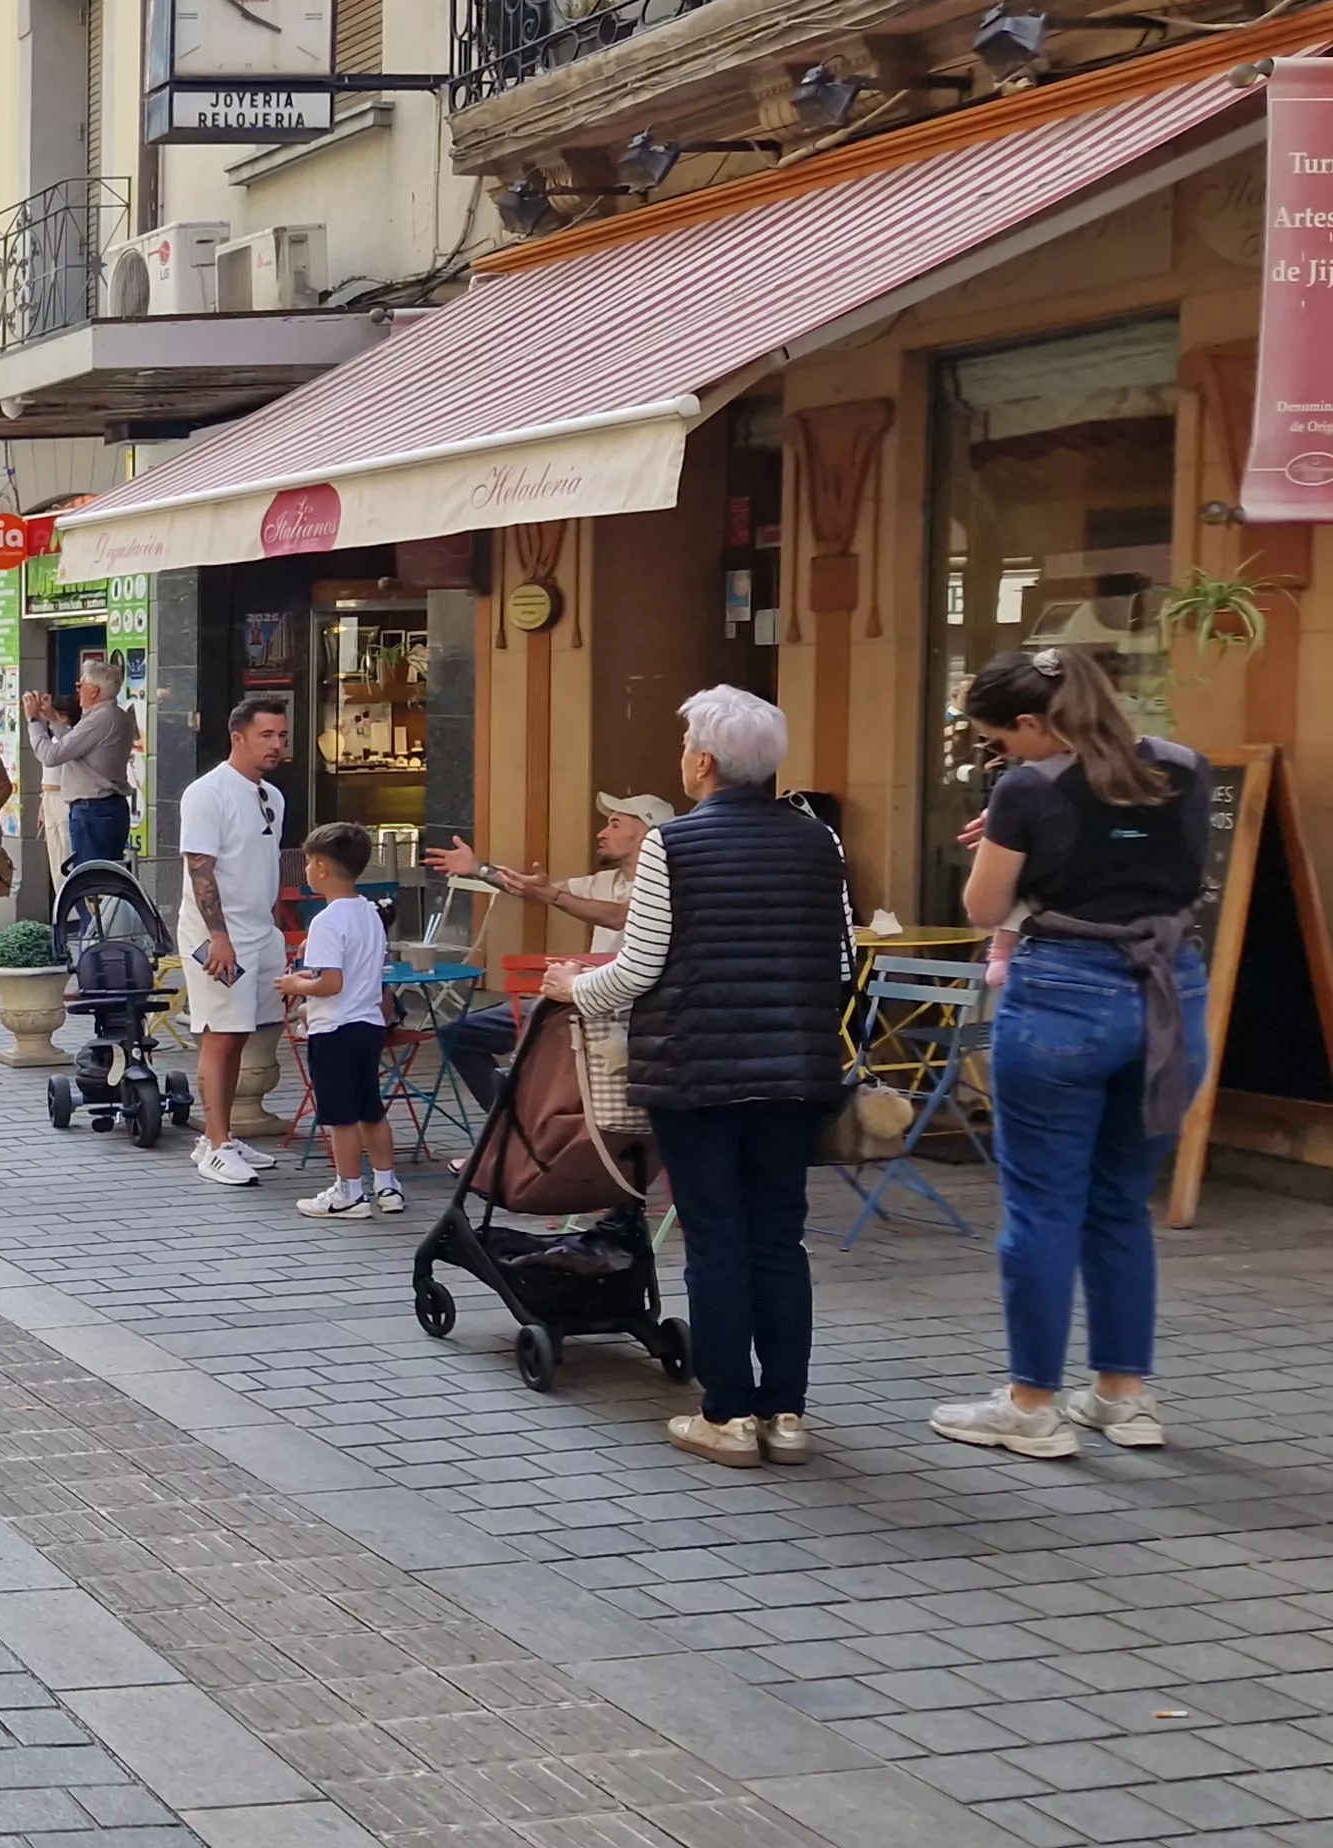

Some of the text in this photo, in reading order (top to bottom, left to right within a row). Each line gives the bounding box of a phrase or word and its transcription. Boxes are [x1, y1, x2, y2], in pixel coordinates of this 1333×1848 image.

[210, 92, 294, 108] JOYERIA
[198, 112, 305, 128] RELOJERIA
[1288, 152, 1333, 175] Tur
[159, 268, 170, 281] LG
[1273, 259, 1301, 282] de
[263, 510, 337, 544] Italianos
[246, 613, 279, 622] 2026
